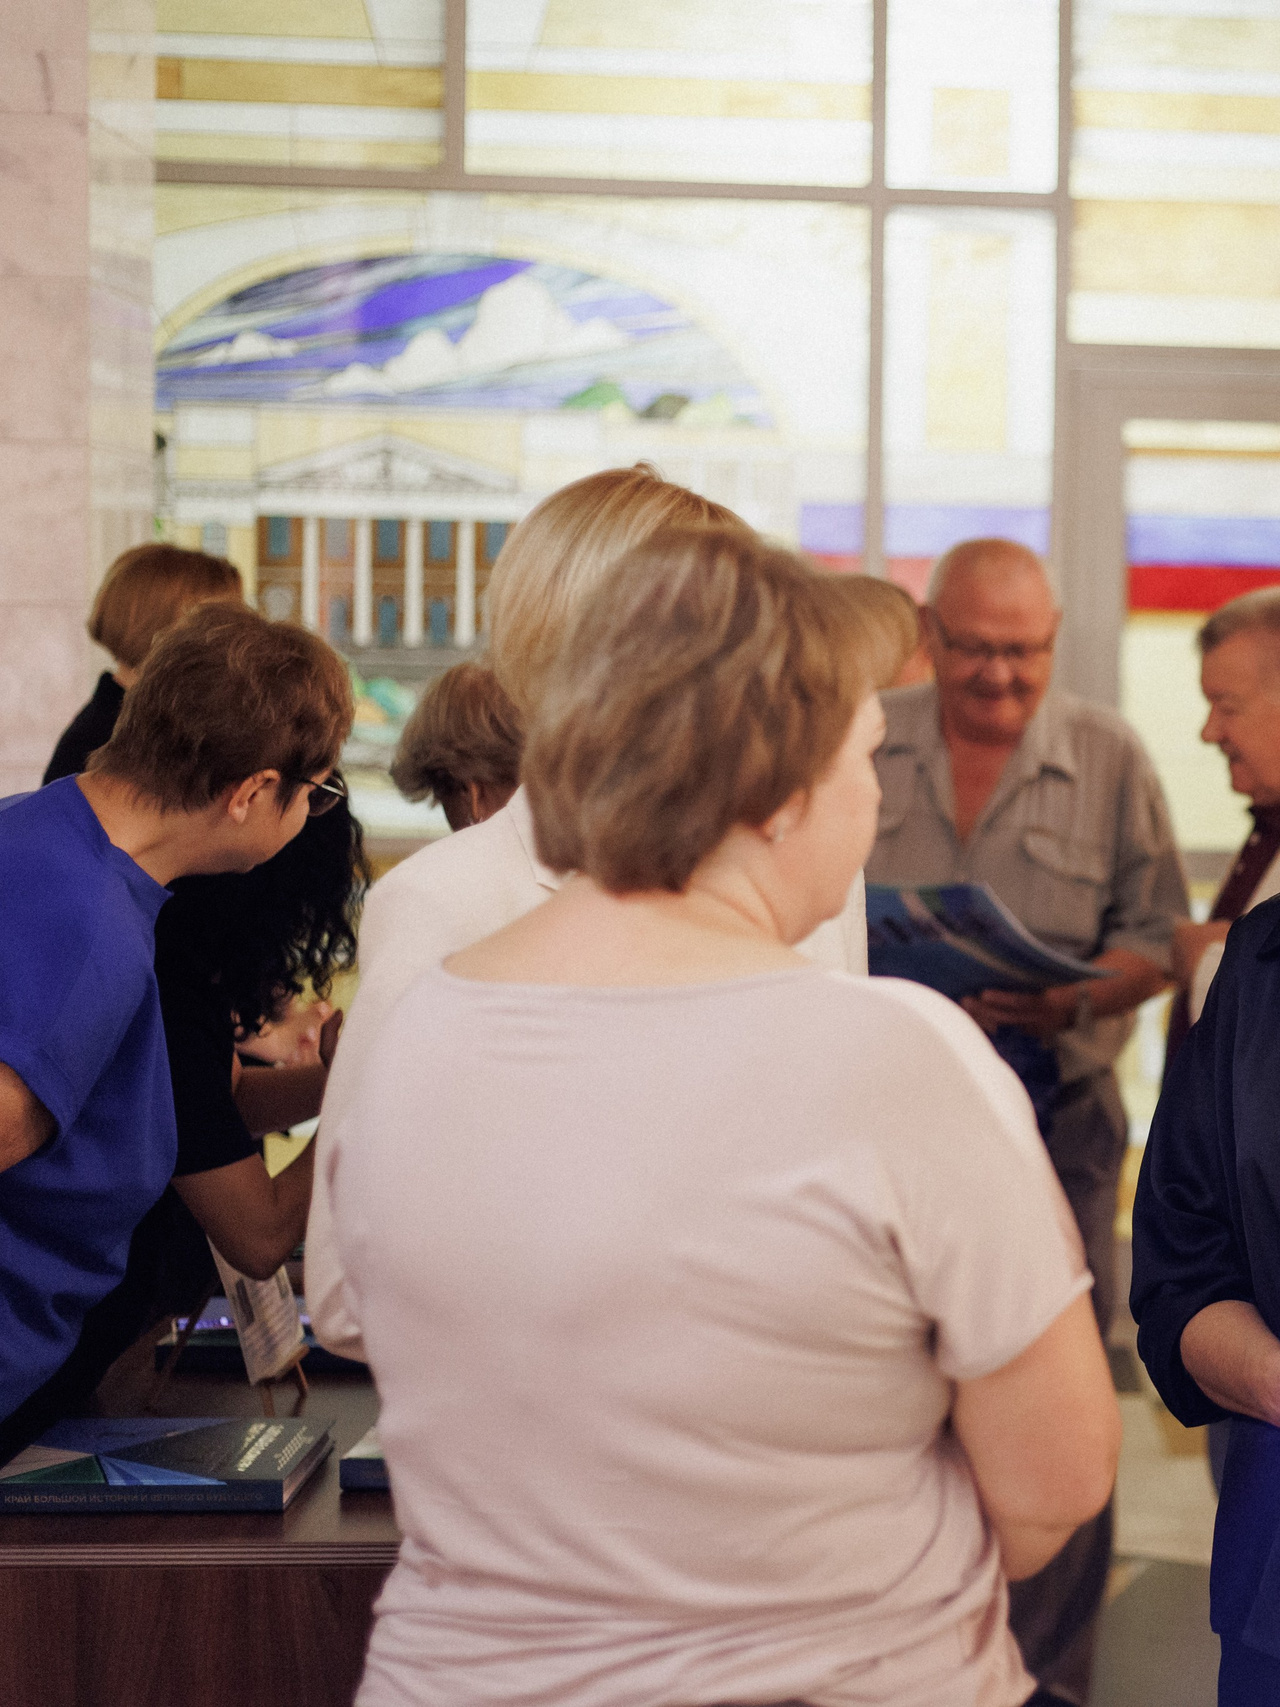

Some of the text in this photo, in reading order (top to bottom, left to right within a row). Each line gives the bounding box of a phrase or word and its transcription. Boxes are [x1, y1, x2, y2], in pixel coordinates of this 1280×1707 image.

[4, 1493, 32, 1503] КРАЙ
[34, 1493, 87, 1503] БОЛЬШОЙ
[89, 1493, 139, 1503] ИСТОРИИ
